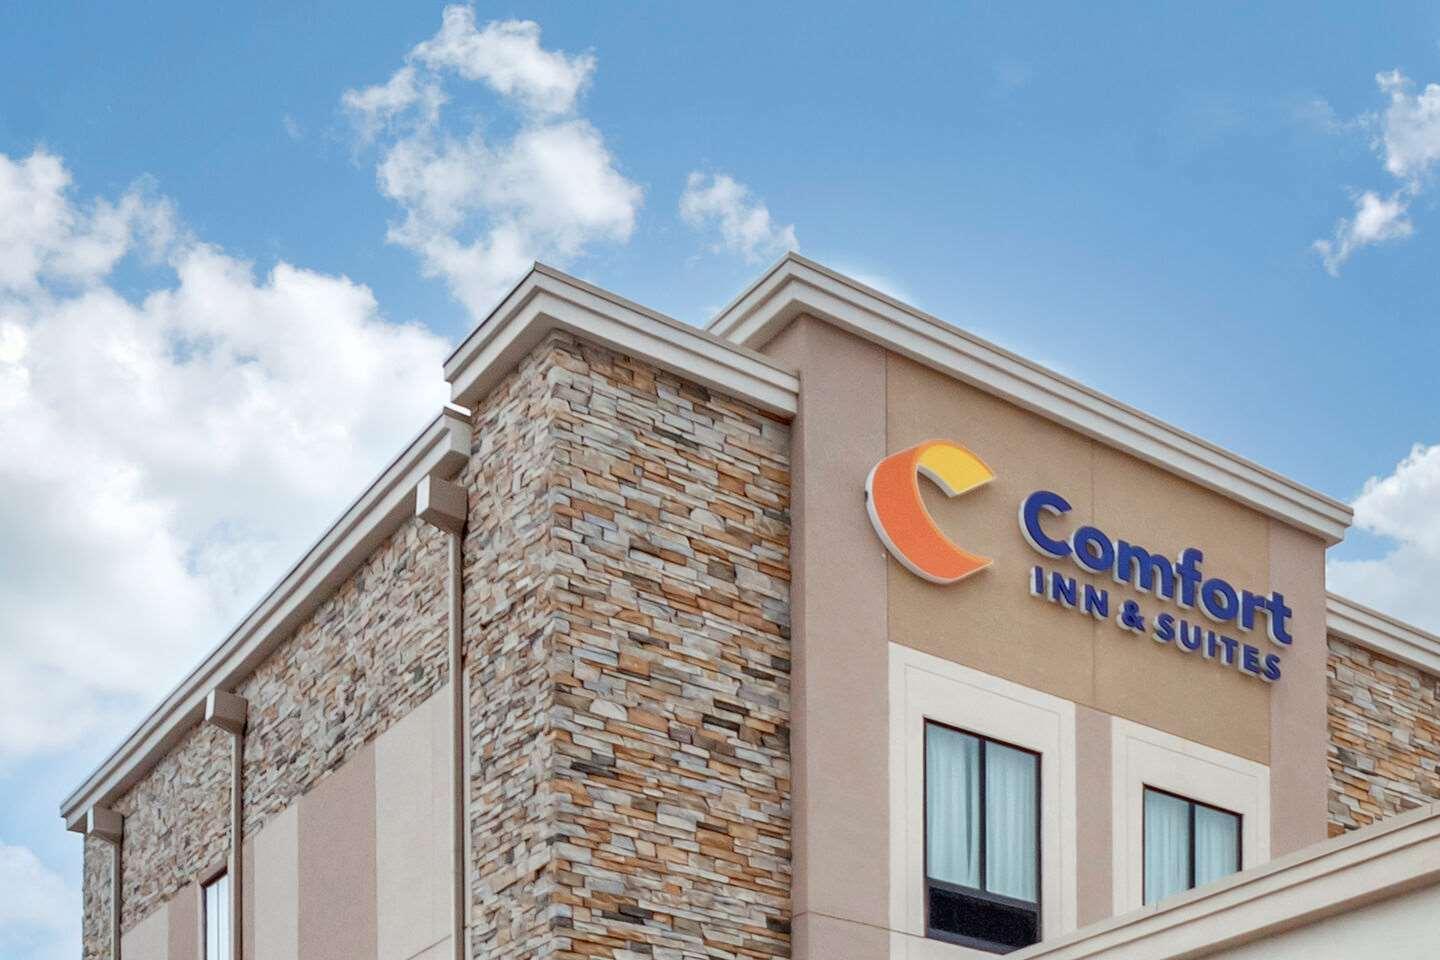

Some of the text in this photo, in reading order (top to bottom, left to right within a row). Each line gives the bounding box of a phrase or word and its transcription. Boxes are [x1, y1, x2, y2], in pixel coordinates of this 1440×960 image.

[1019, 490, 1293, 648] Comfort
[1030, 565, 1282, 683] INN & SUITES
